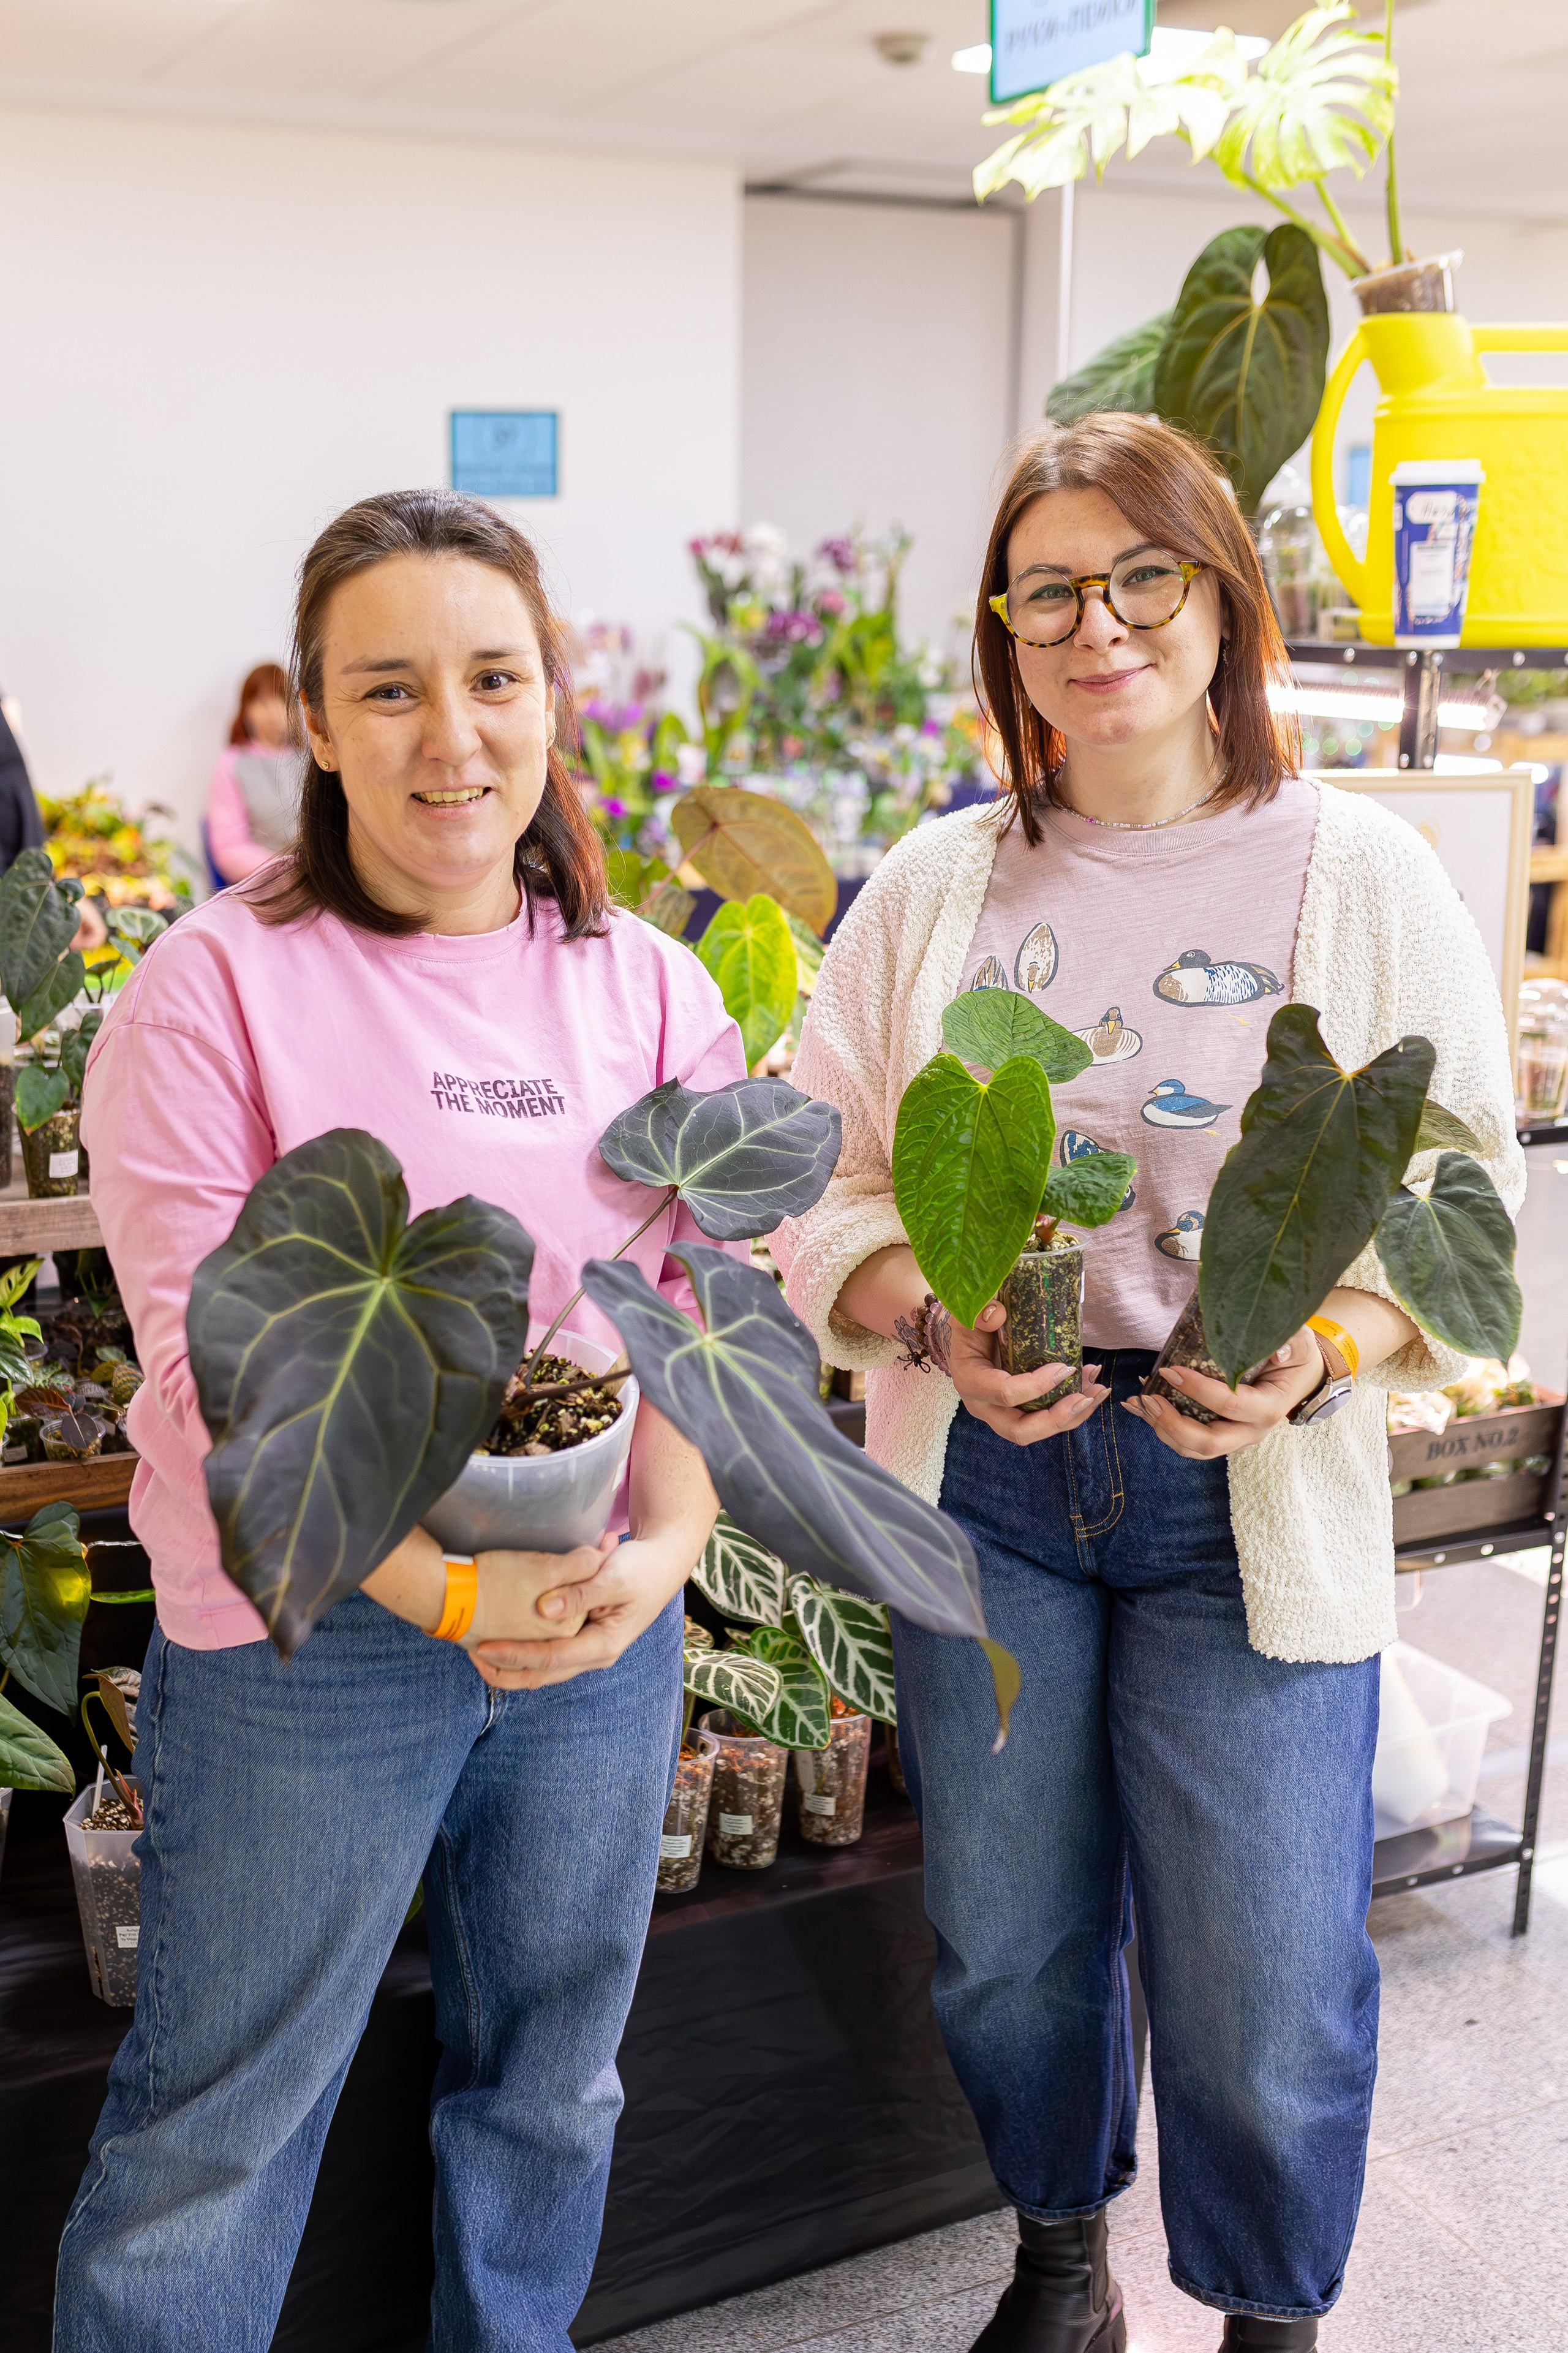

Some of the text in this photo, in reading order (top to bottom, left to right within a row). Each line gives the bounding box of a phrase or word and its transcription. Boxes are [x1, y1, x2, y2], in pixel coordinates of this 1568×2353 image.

[433, 1071, 558, 1100] APPRECIATE
[431, 1090, 565, 1119] THE MOMENT
[1426, 1435, 1468, 1461] BOX
